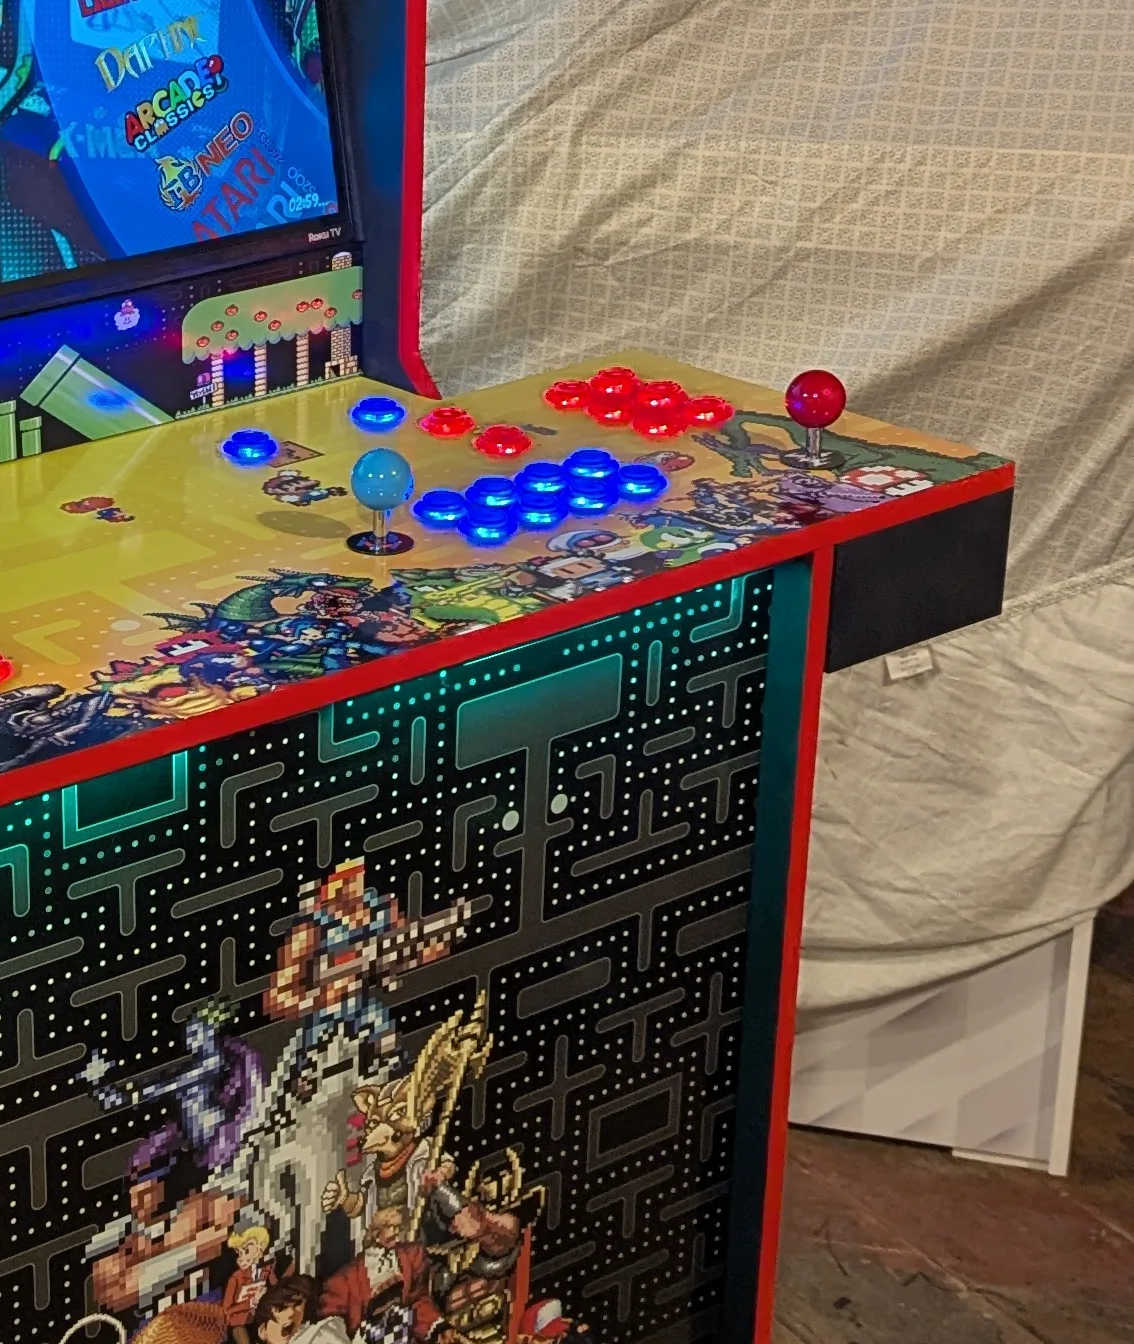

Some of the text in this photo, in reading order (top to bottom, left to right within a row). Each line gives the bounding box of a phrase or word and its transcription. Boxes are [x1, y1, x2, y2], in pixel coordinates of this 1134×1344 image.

[124, 56, 211, 145] ARCADE
[195, 111, 255, 177] NEO
[191, 147, 276, 242] ATARI
